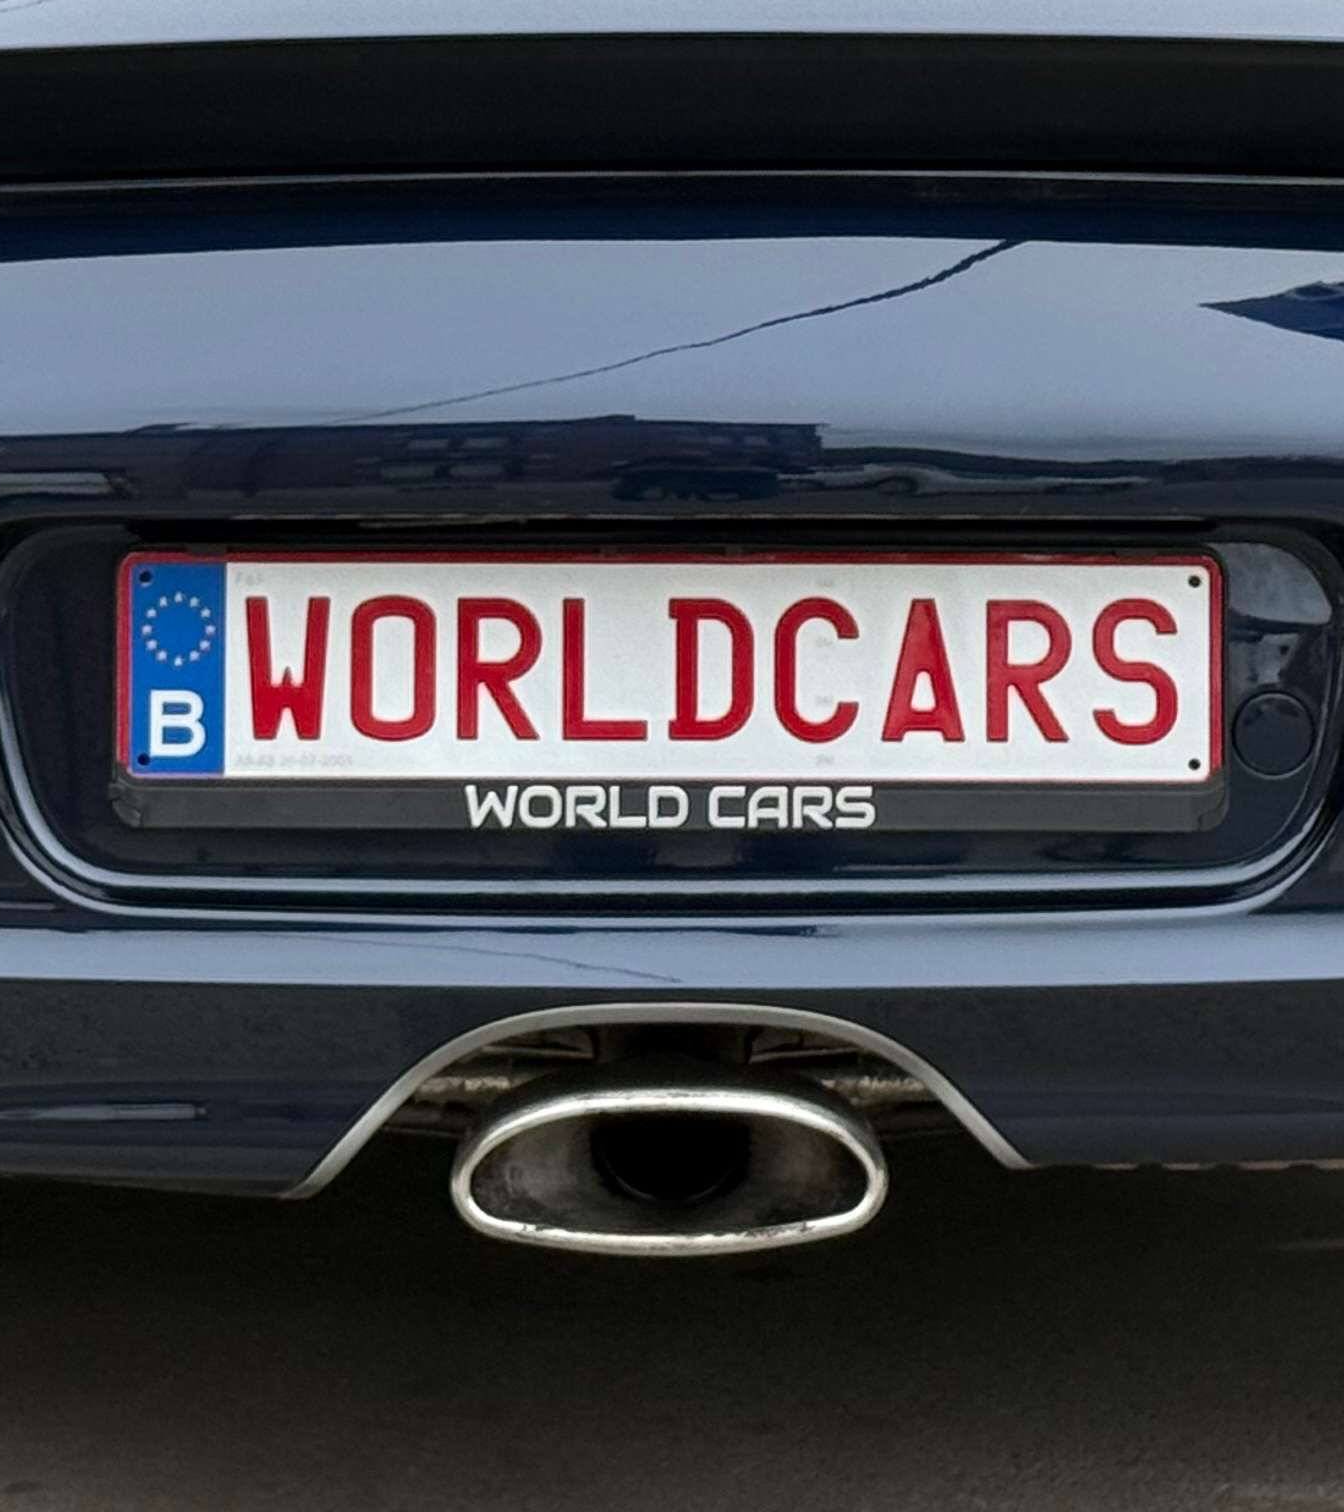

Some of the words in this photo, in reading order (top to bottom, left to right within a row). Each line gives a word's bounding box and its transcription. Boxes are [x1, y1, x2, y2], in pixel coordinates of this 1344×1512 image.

[149, 688, 206, 756] B
[244, 595, 1179, 746] WORLDCARS
[464, 784, 690, 829] WORLD
[708, 784, 877, 829] CARS
